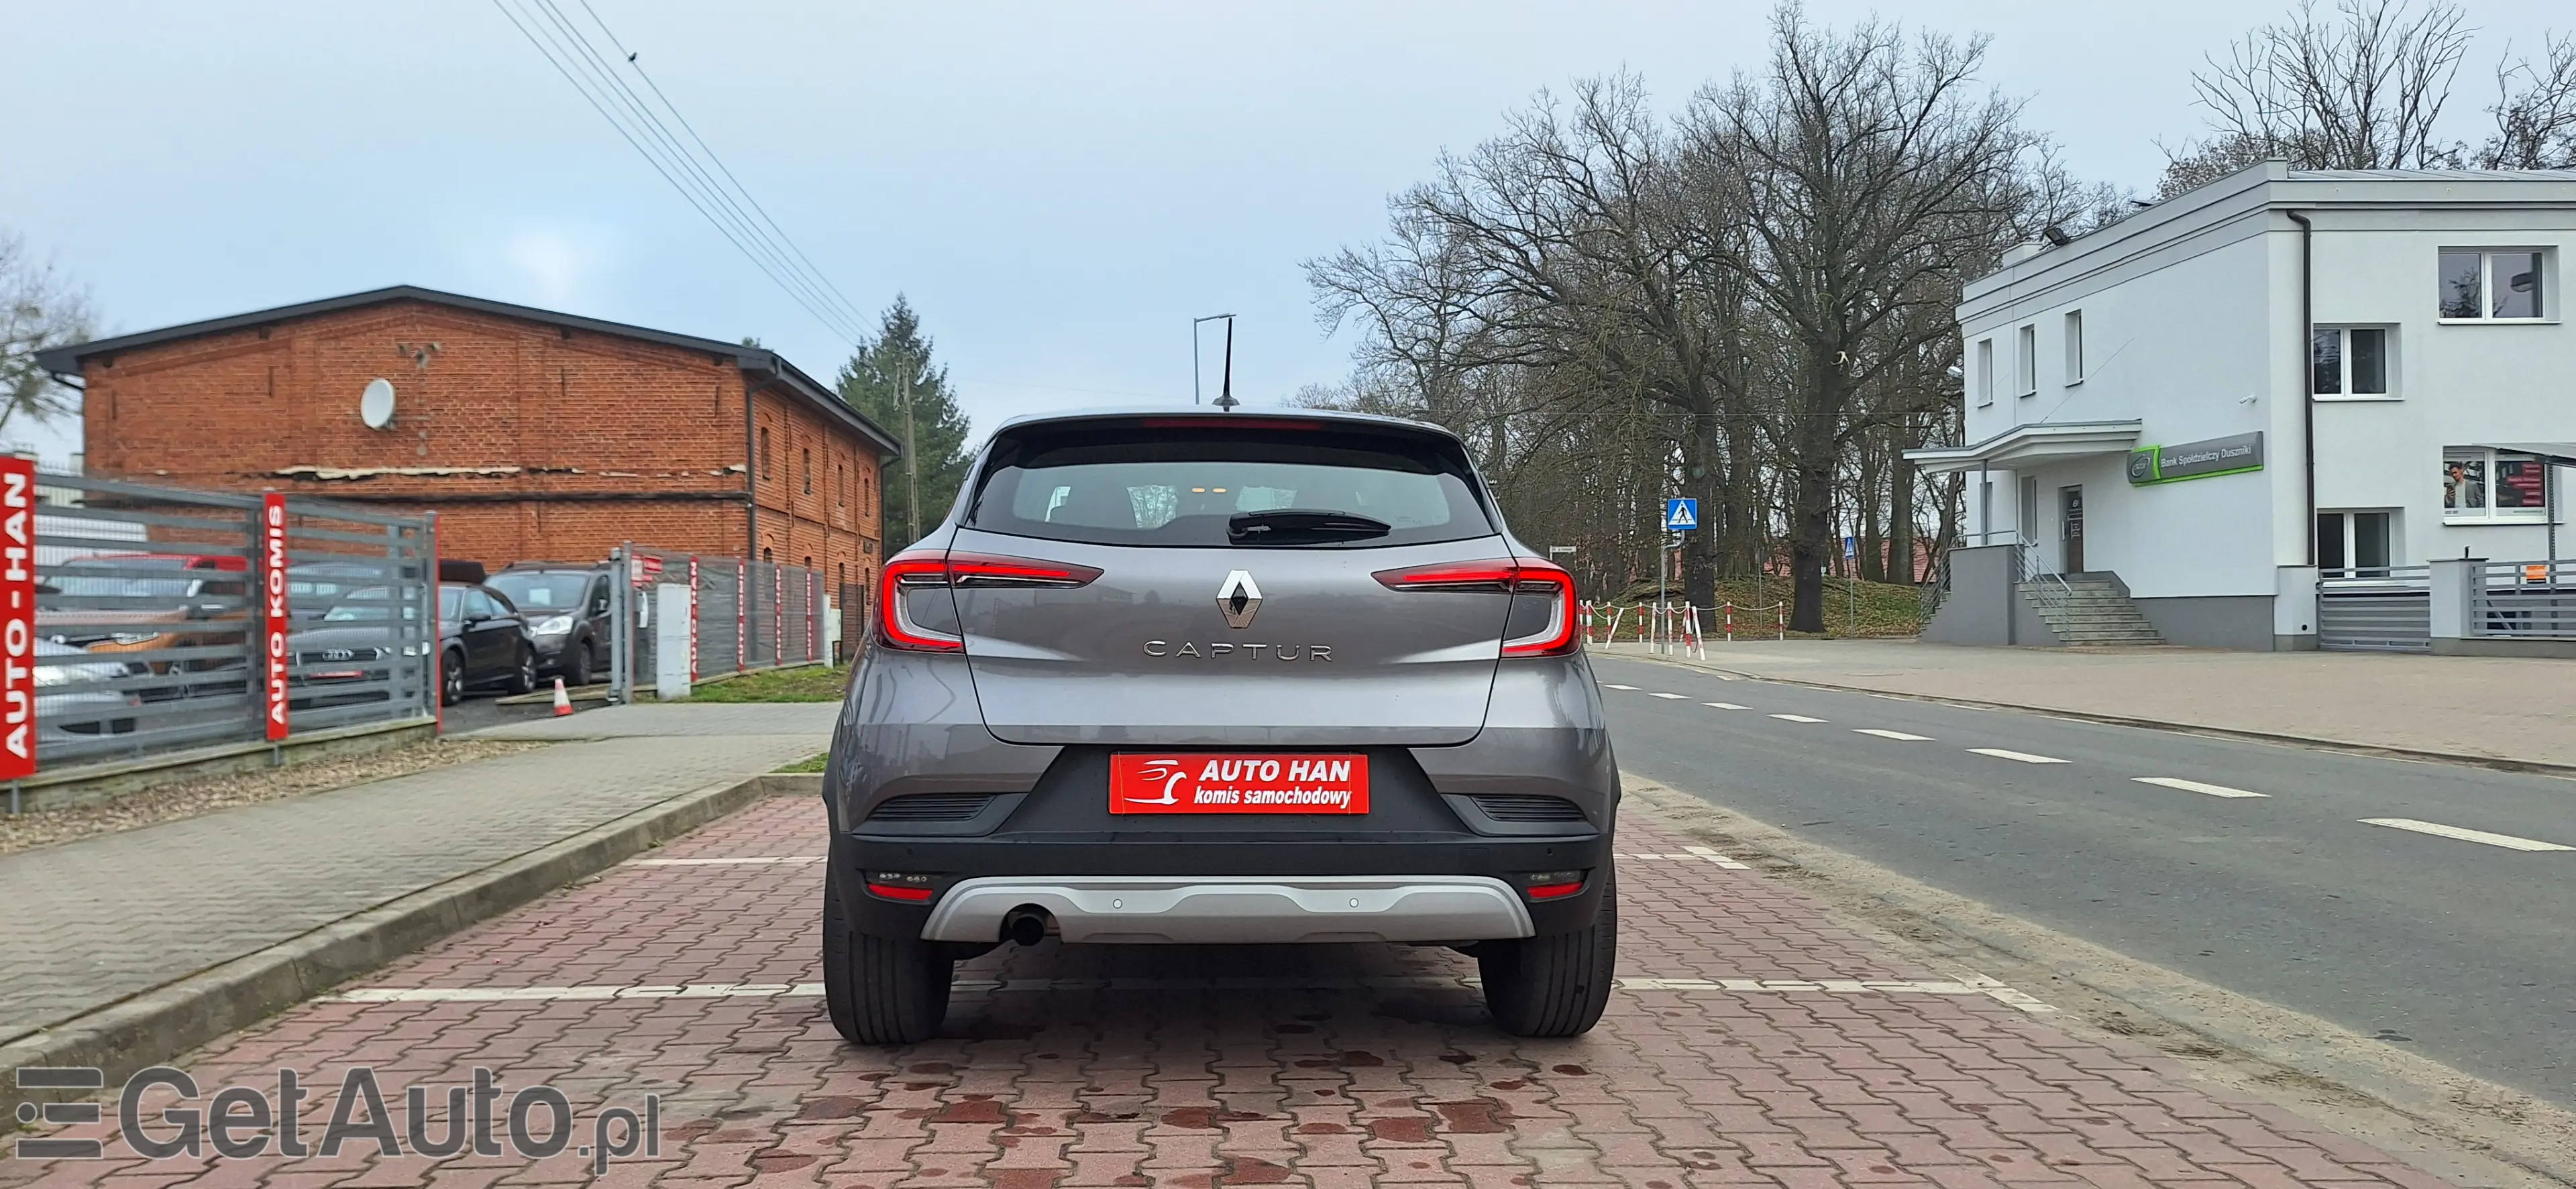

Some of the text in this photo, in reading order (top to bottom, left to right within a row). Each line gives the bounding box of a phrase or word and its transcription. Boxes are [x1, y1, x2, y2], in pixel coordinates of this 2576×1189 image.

[2161, 457, 2178, 467] Bank
[2178, 451, 2220, 467] Spółdzielczy
[2221, 445, 2251, 458] Duszniki
[270, 506, 285, 724] AUTO KOMIS
[1143, 640, 1333, 662] CAPTUR
[1198, 759, 1351, 783] AUTO HAN
[1194, 785, 1352, 809] komis samochodowy
